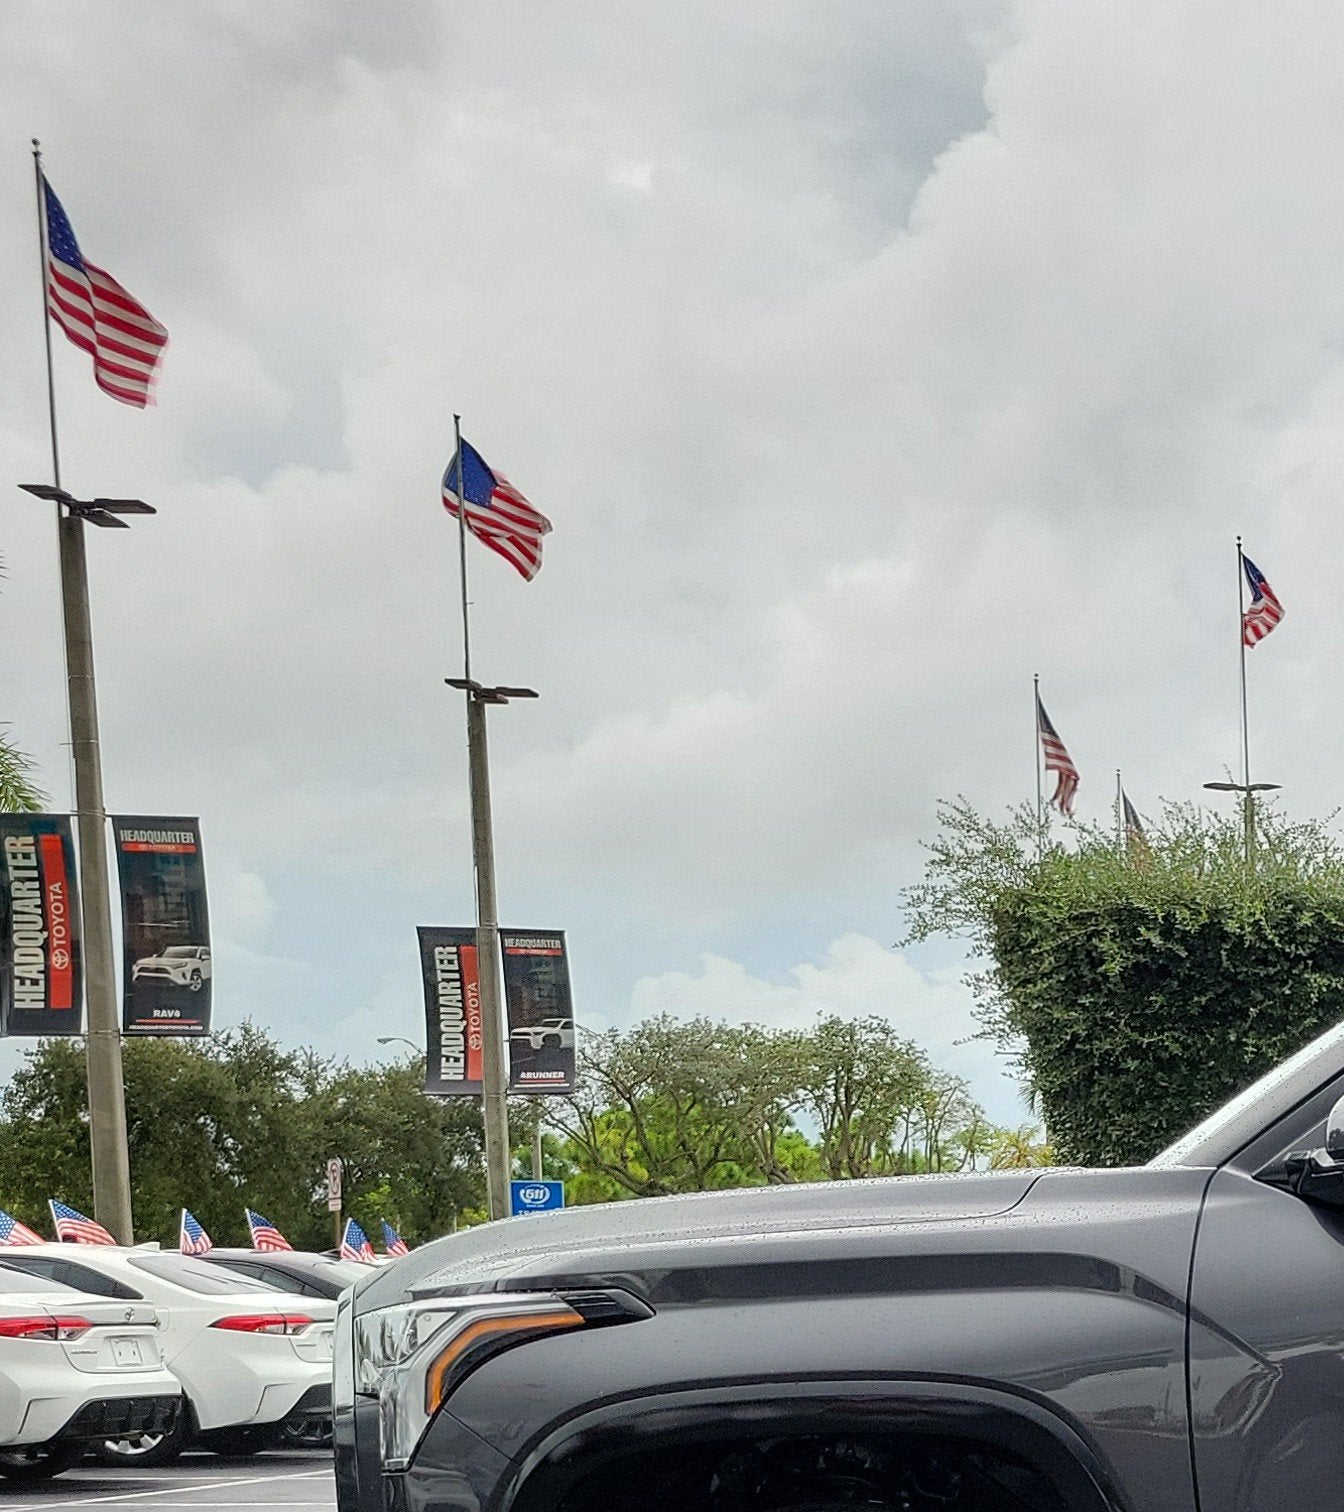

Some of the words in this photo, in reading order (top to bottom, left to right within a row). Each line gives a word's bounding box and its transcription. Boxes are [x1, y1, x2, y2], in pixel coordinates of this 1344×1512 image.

[120, 830, 194, 844] HEADQUARTER
[4, 836, 48, 1009] HEADQUARTER
[50, 881, 66, 947] TOYOTA
[153, 1009, 180, 1018] RAV4
[434, 946, 467, 1081] HEADQUARTER
[468, 982, 480, 1034] TOYOTA
